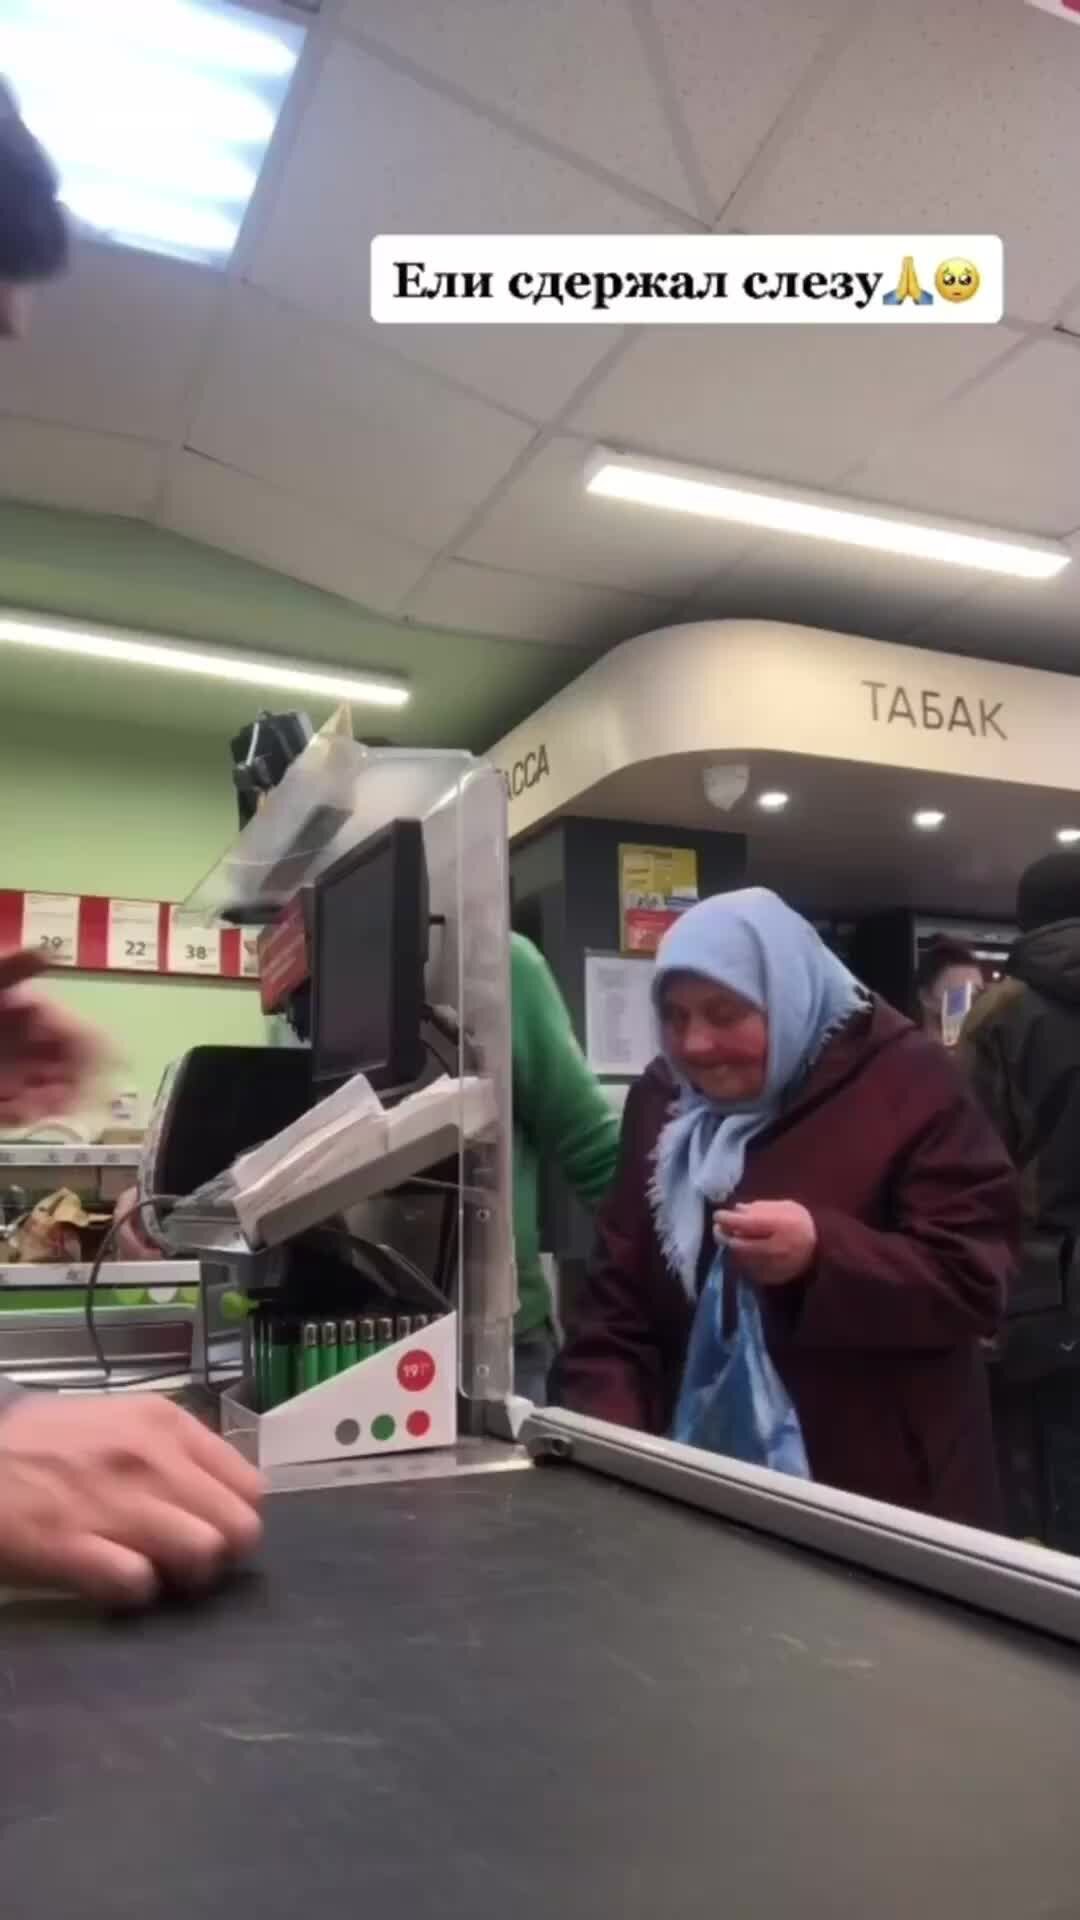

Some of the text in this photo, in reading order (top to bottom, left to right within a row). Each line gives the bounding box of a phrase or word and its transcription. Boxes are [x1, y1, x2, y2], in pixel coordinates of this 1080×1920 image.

[861, 680, 1008, 740] ТАБАК
[124, 940, 146, 956] 22
[185, 944, 208, 960] 38
